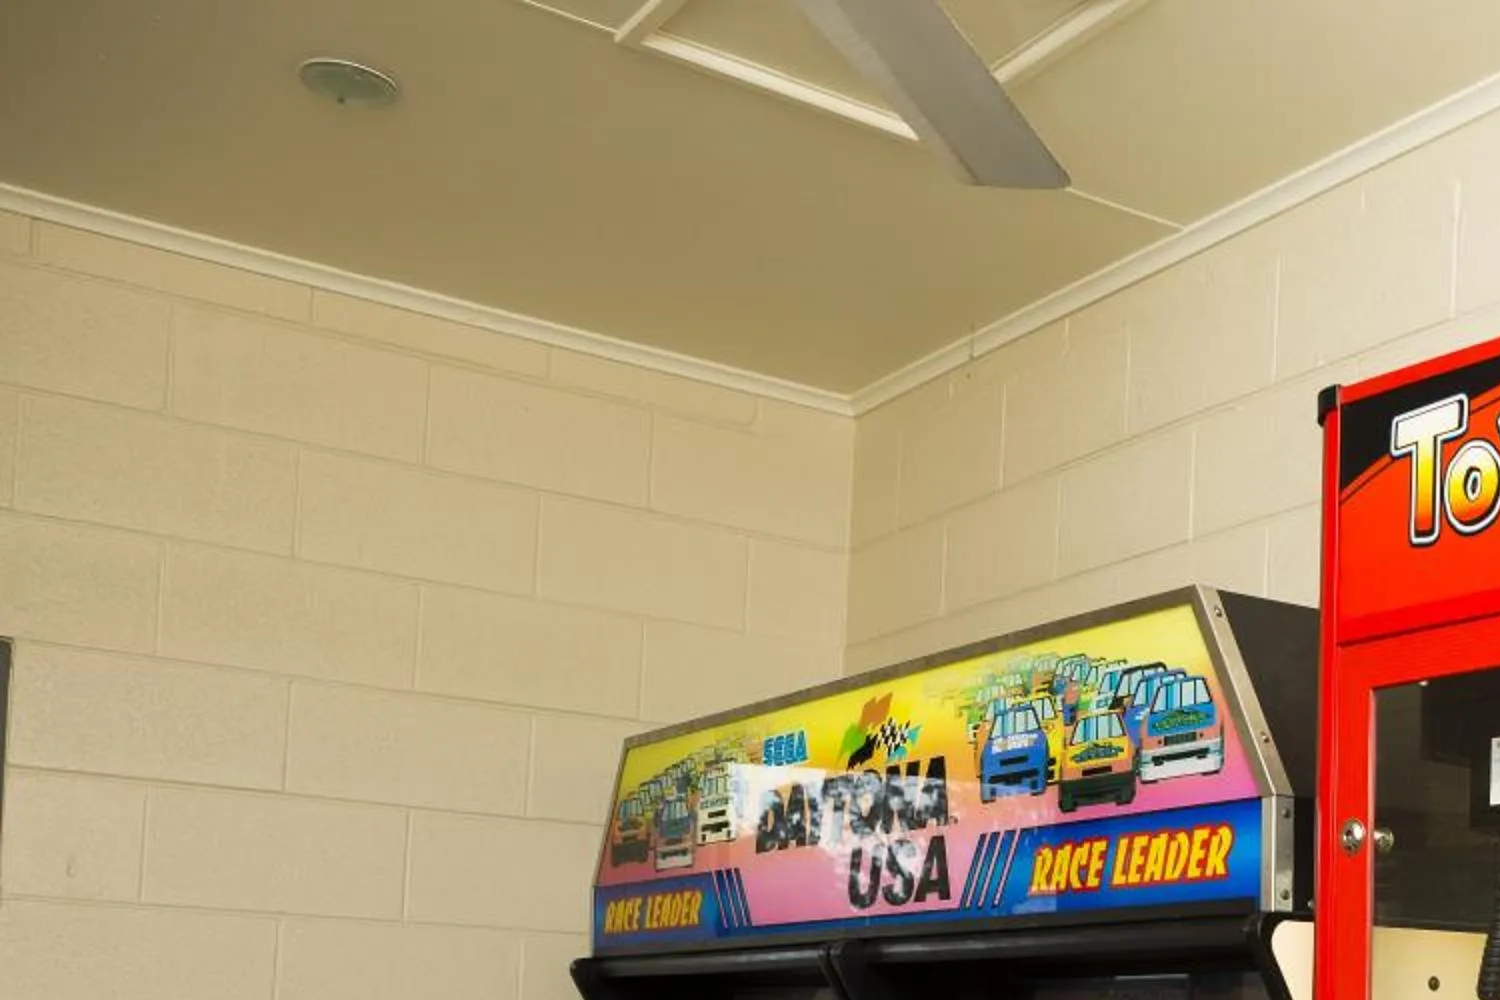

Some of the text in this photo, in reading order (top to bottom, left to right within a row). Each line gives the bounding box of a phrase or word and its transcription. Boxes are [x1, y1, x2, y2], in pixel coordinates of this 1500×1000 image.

[762, 729, 809, 767] SEGA
[848, 834, 952, 909] USA
[1029, 821, 1234, 897] RACE LEADER
[603, 887, 703, 935] RACE LEADER
